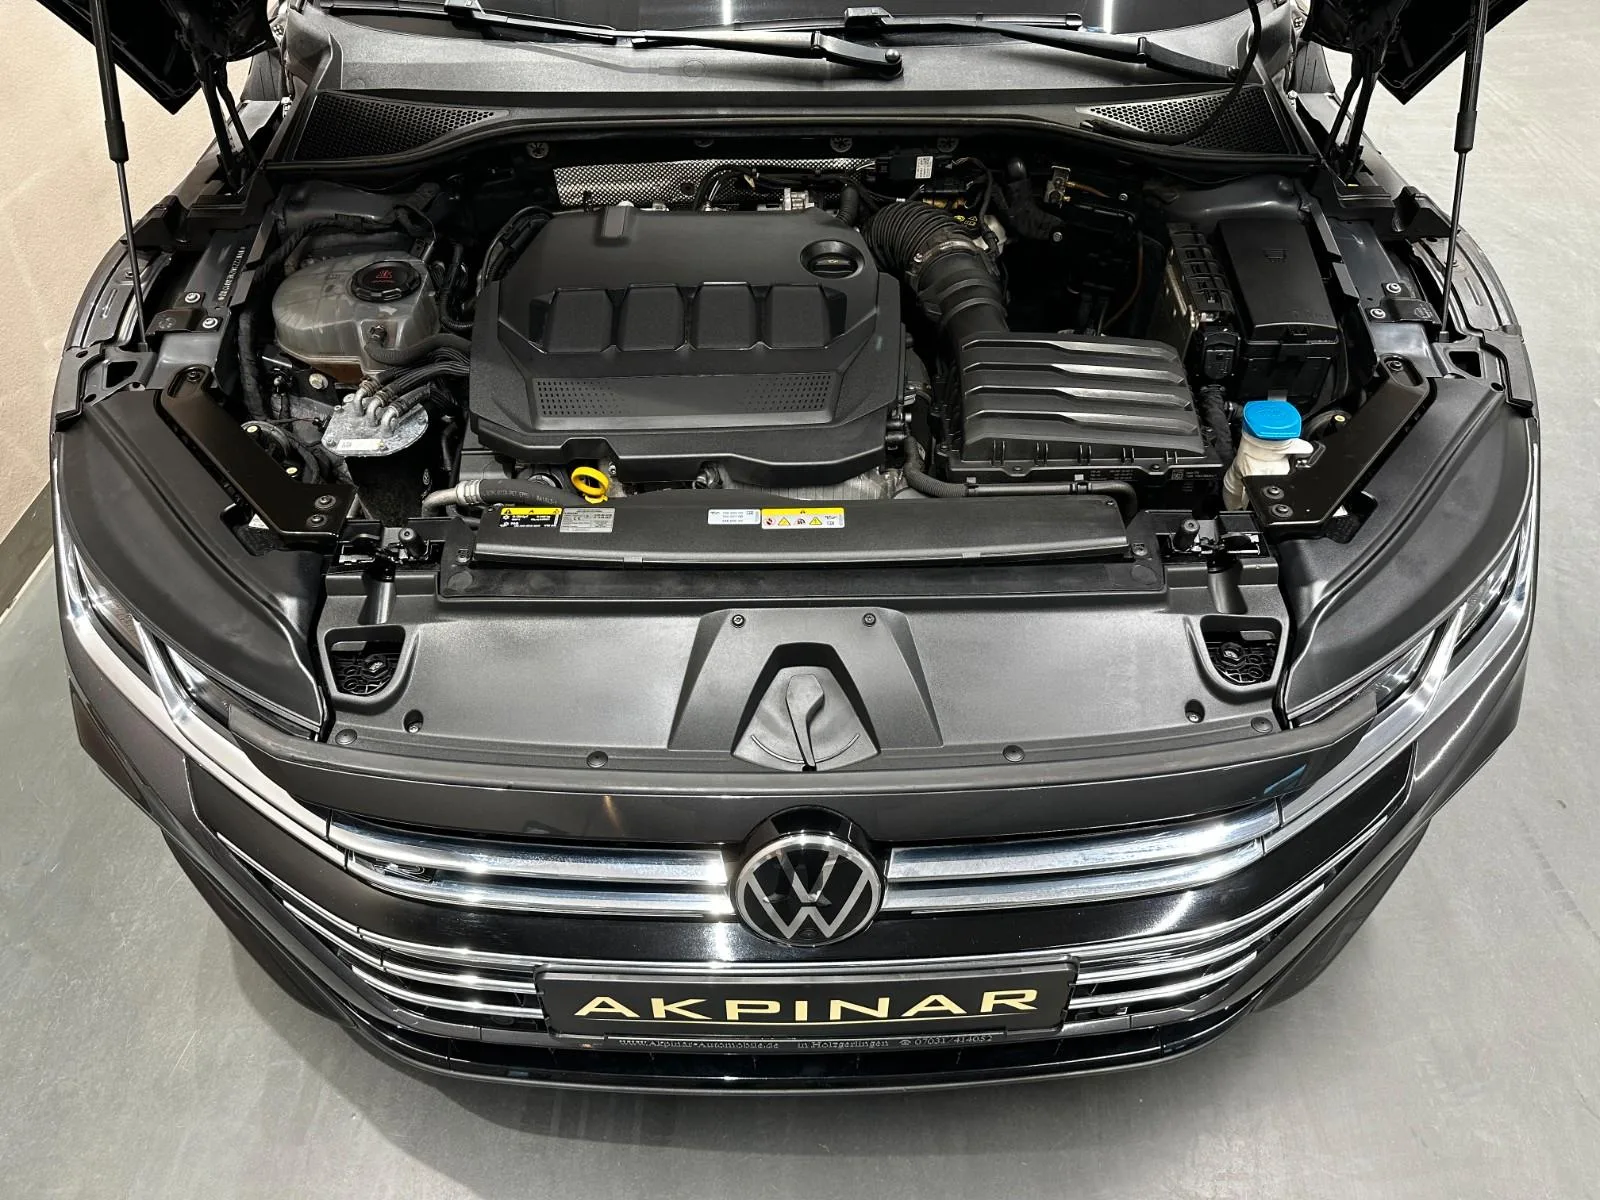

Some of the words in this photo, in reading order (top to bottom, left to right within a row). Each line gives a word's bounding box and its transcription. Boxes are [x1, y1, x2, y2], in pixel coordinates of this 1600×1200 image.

[742, 843, 876, 942] VW
[574, 989, 1039, 1021] AKPINAR
[810, 1039, 889, 1050] Holzgerlingen
